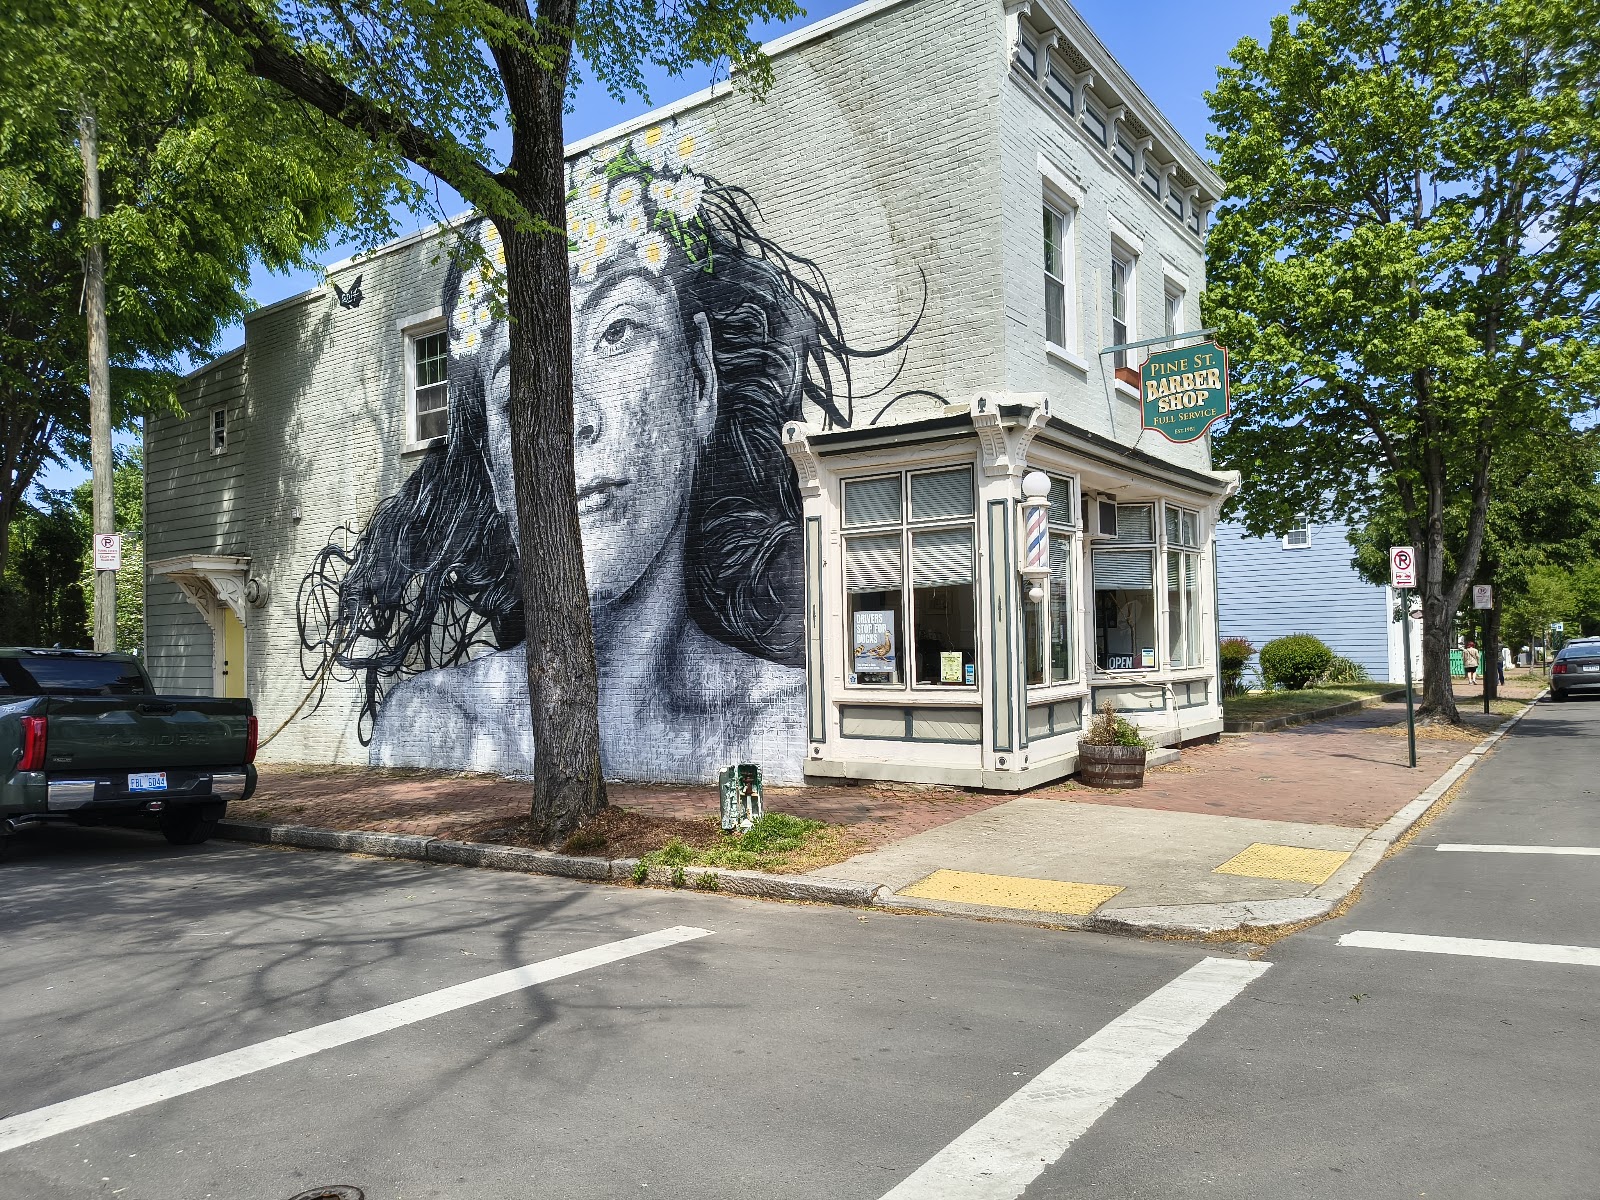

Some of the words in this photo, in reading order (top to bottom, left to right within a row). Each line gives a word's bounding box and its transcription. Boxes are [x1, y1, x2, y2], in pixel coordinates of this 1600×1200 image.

[1150, 359, 1188, 376] PINE
[1194, 353, 1216, 368] ST.
[1145, 368, 1222, 403] BARBER
[1158, 390, 1209, 413] SHOP
[1153, 415, 1176, 425] FULL
[1178, 408, 1217, 421] SERVICE
[856, 613, 883, 623] DRIVERS
[856, 624, 873, 634] STOP
[874, 623, 887, 633] FOR
[856, 633, 878, 644] DUCKS
[1109, 656, 1133, 669] OPEN
